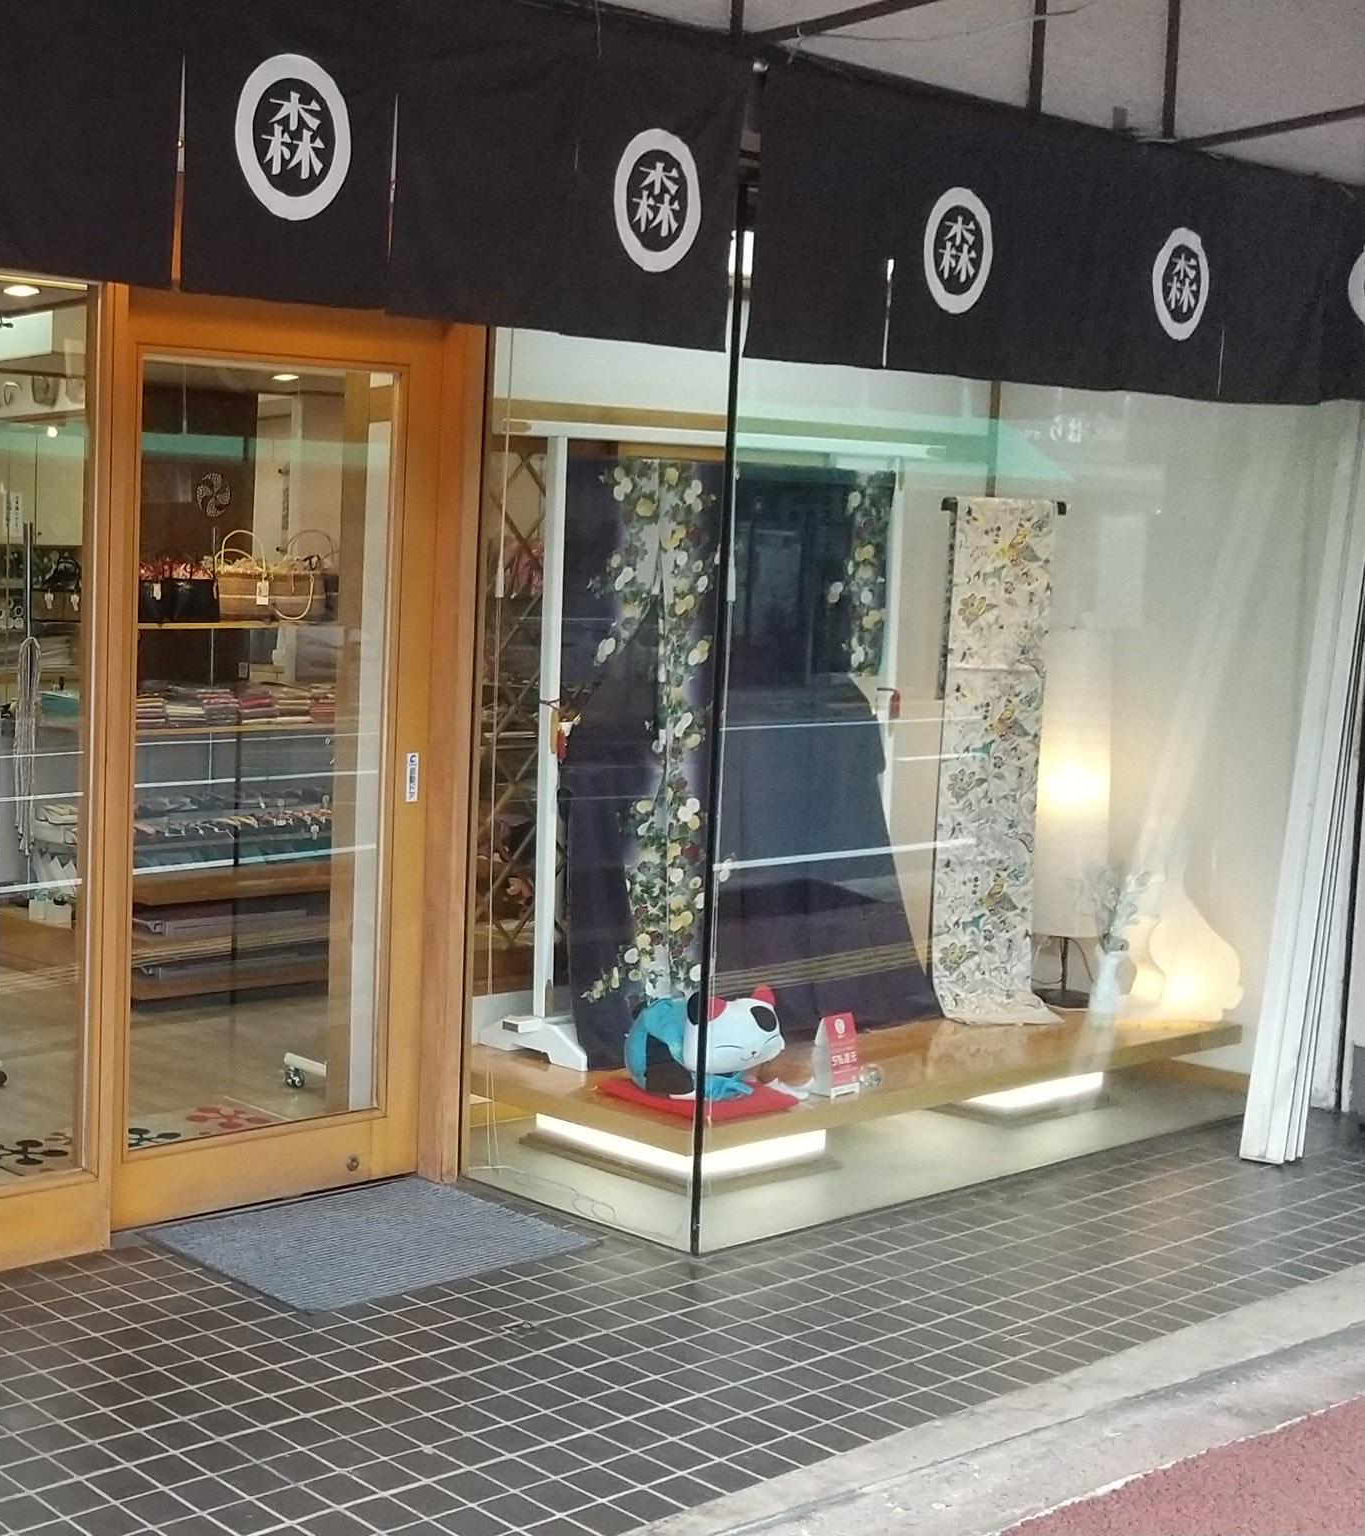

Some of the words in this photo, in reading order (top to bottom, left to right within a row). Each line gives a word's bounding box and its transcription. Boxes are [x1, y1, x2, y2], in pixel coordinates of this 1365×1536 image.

[261, 91, 325, 180] 森
[632, 161, 680, 237] 森
[938, 215, 976, 283] 森
[1166, 253, 1198, 313] 森
